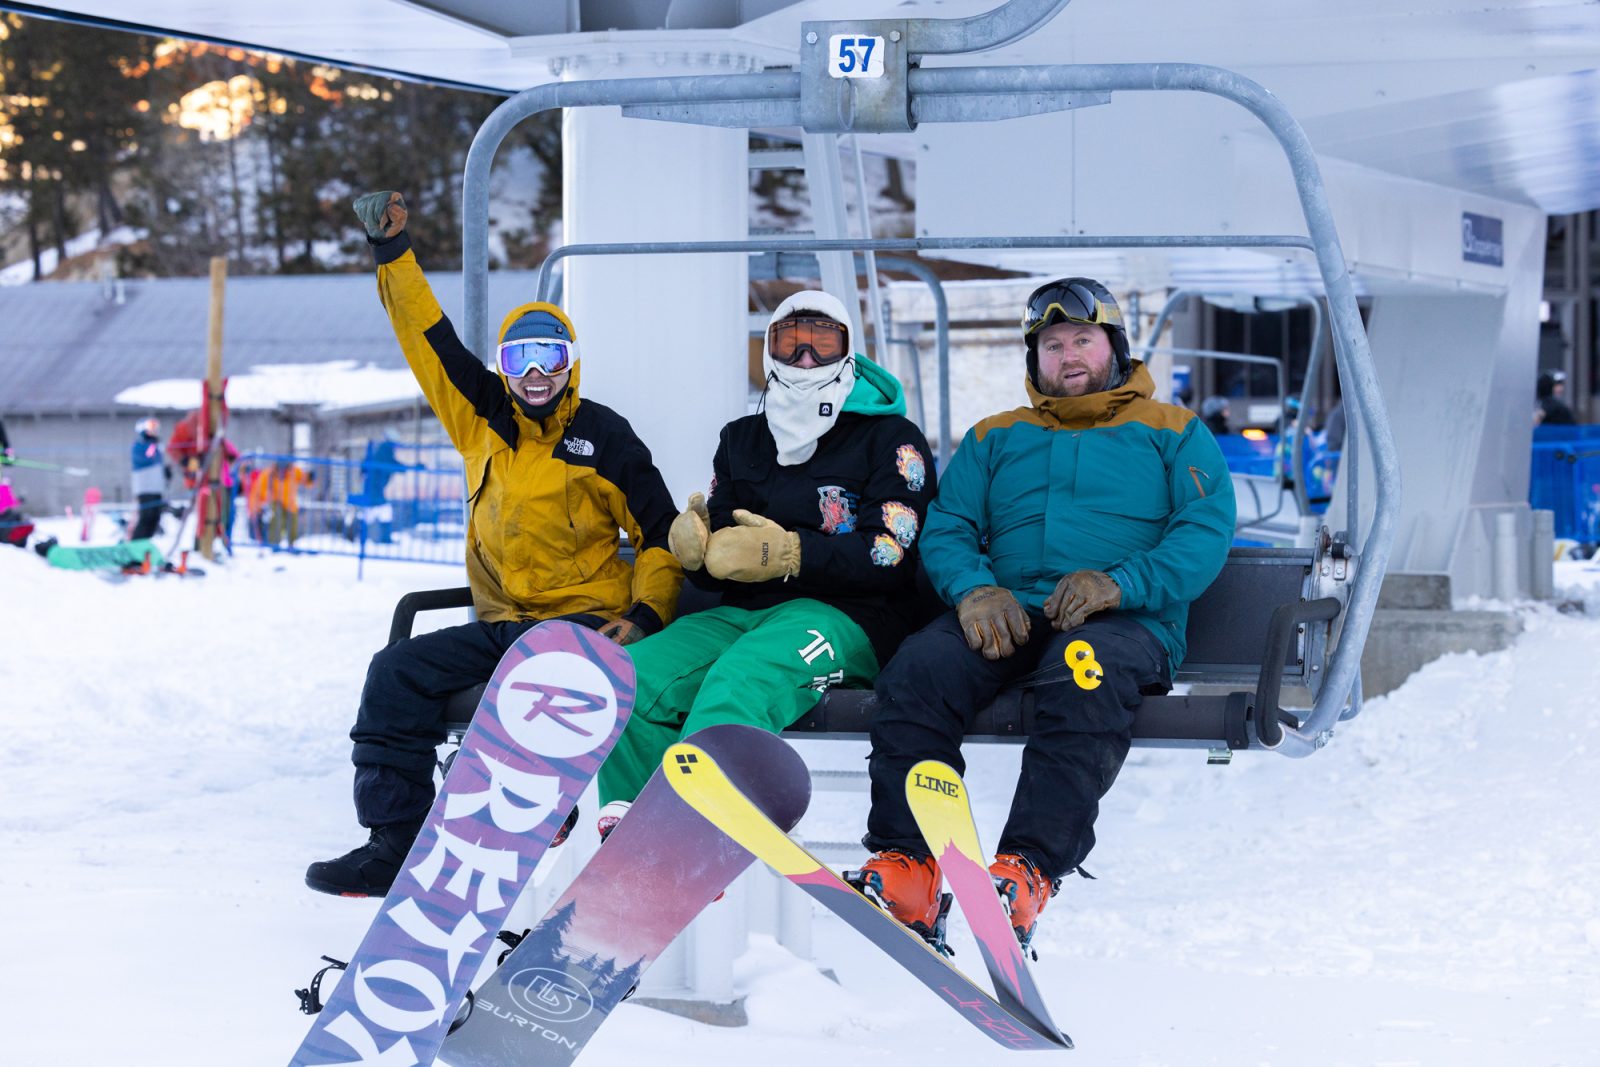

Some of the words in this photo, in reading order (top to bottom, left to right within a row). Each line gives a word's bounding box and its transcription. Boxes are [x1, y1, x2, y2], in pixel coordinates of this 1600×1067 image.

[839, 38, 875, 72] 57
[564, 438, 584, 451] NORTH
[567, 444, 583, 455] FACE
[573, 437, 585, 446] THE
[761, 542, 769, 567] KINCO
[914, 772, 959, 798] LINE
[475, 998, 577, 1050] BURTON
